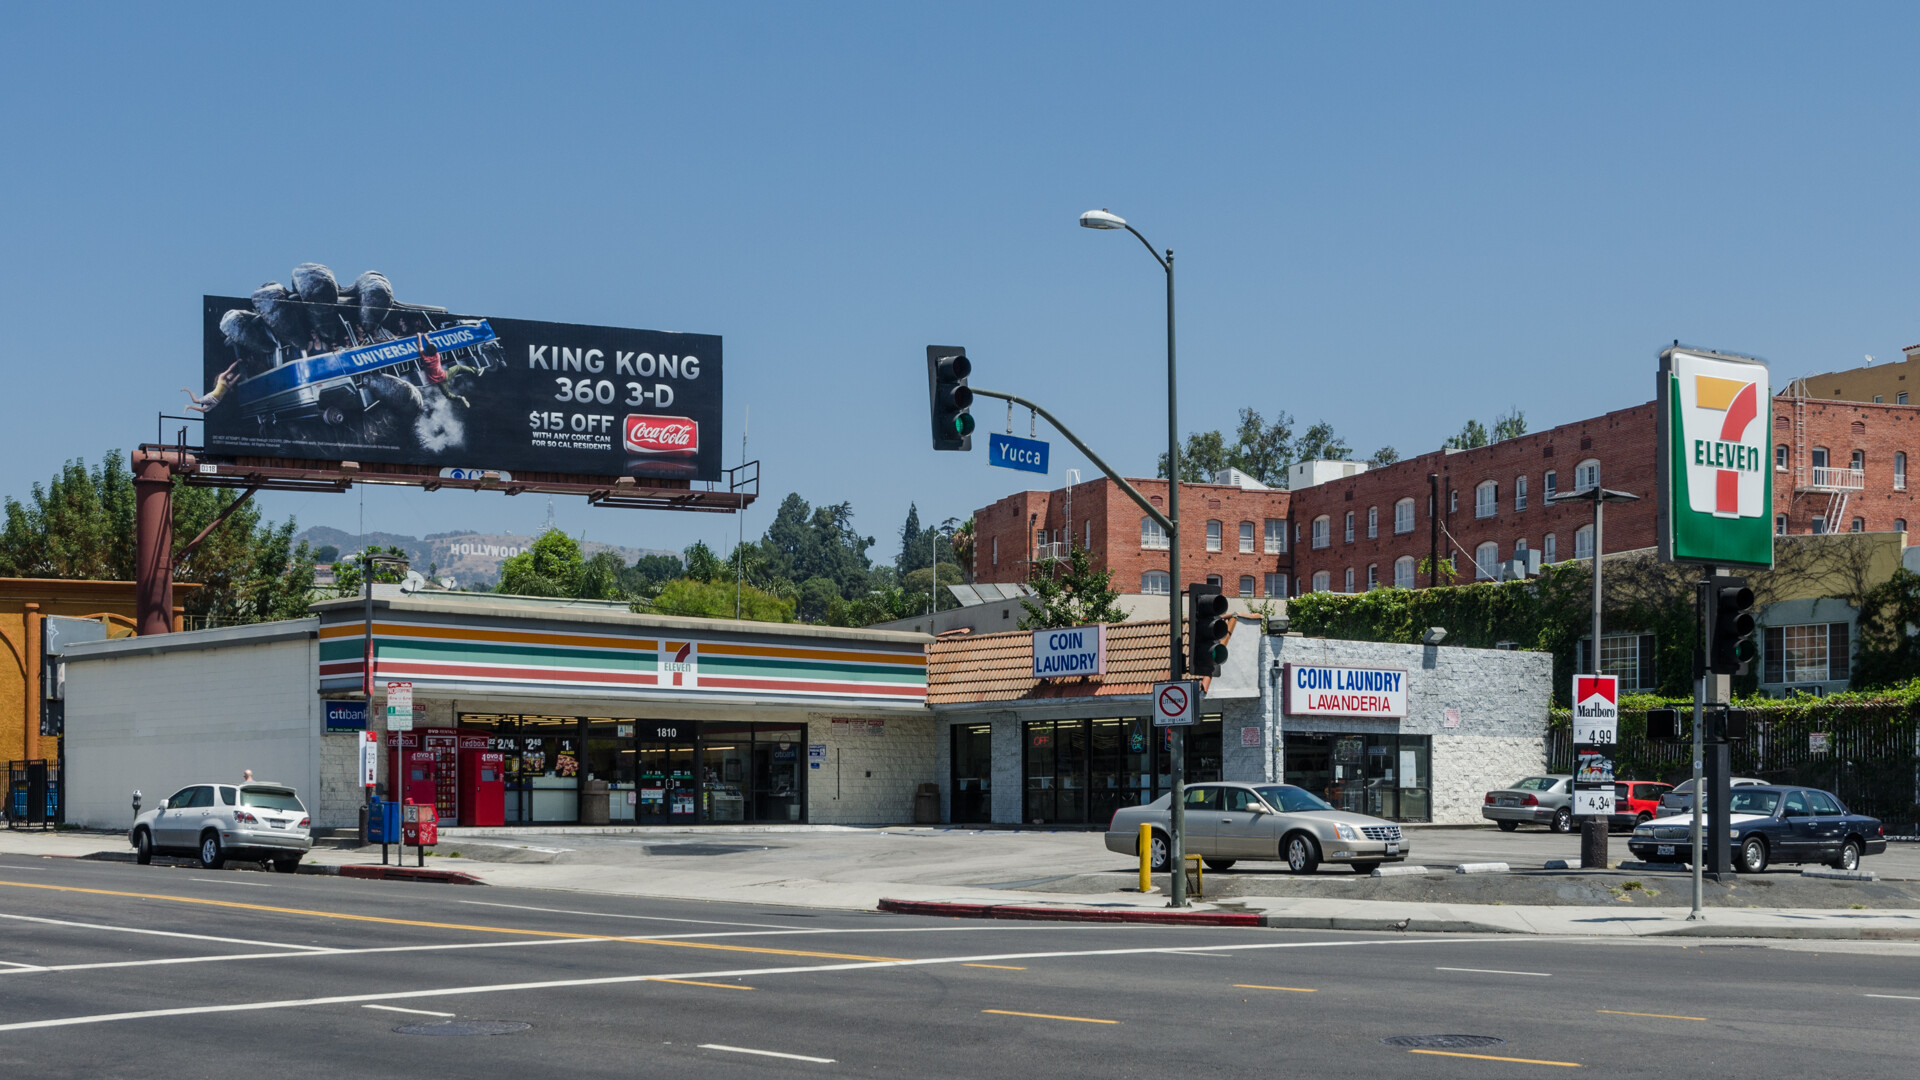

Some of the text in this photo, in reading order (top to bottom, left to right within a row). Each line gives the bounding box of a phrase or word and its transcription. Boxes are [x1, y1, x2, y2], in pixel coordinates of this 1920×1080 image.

[529, 344, 700, 380] KING KONG
[554, 377, 674, 408] 360 3-D
[529, 411, 614, 433] $15 OFF
[532, 431, 551, 439] WITH
[553, 432, 569, 440] ANY
[630, 422, 692, 445] Coca-Cola
[573, 442, 611, 450] RESIDENTS
[1000, 443, 1040, 465] Yucca
[1050, 633, 1082, 650] COIN
[1036, 653, 1096, 673] LAUNDRY
[1297, 668, 1401, 692] COIN LAUNDRY
[1308, 694, 1391, 712] LAVANDERIA
[1577, 702, 1615, 717] Marlboro
[657, 728, 677, 738] 1810
[1589, 729, 1612, 744] 4.99
[462, 739, 485, 747] redbox
[1578, 754, 1613, 770] 72s
[1589, 796, 1610, 811] 4.34
